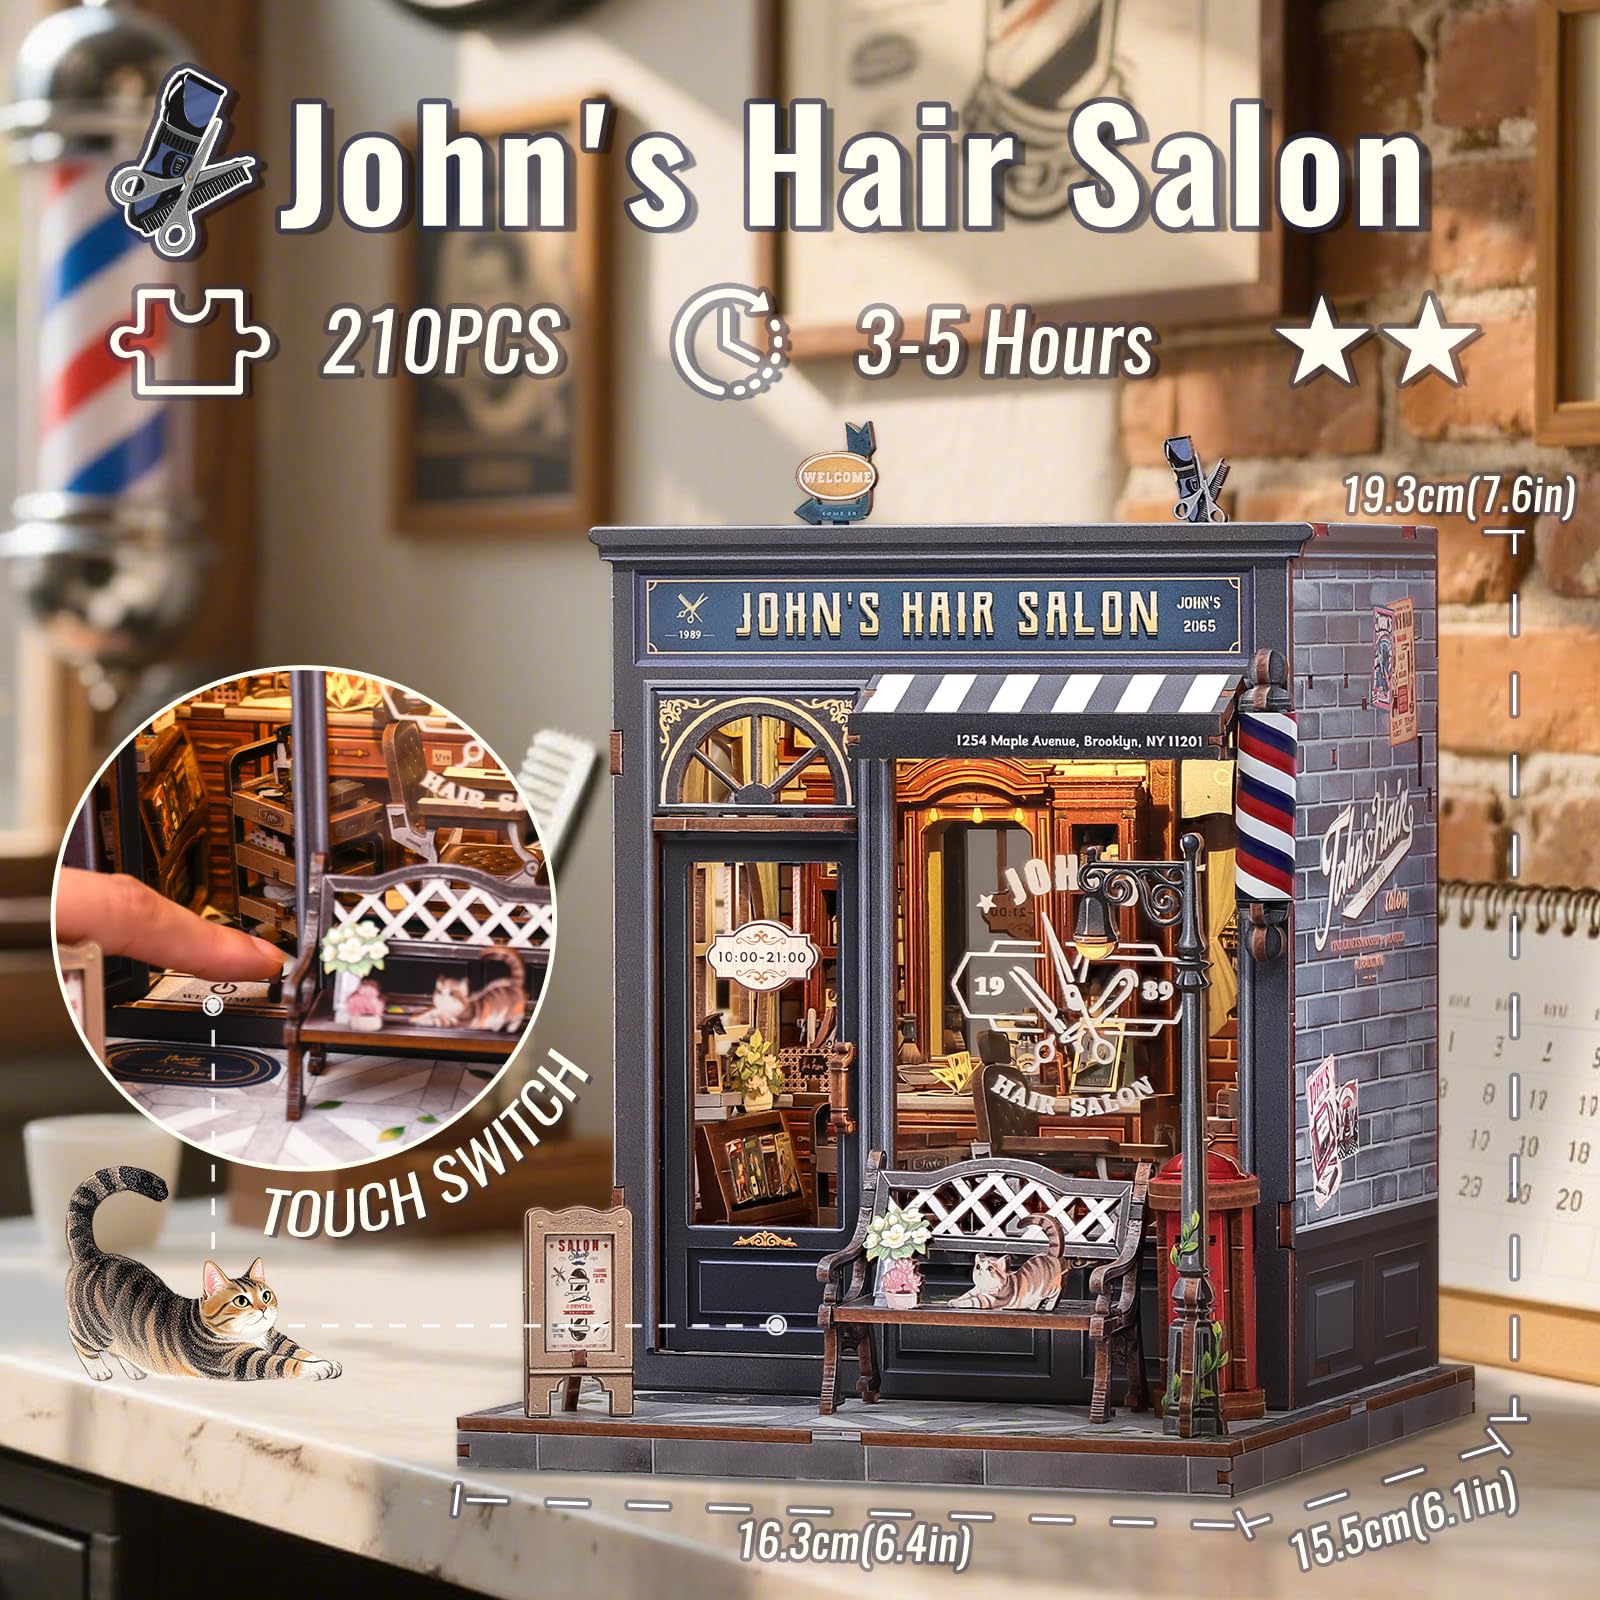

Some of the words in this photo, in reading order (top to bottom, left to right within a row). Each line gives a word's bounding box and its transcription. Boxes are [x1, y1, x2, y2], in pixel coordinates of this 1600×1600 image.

[803, 471, 872, 484] WELCOME
[1176, 595, 1222, 610] JOHN'S
[735, 591, 881, 637] JOHN'S
[902, 591, 995, 637] HAIR
[1017, 591, 1159, 636] SALON
[1182, 618, 1217, 633] 2065
[678, 629, 702, 640] 1989
[956, 734, 988, 747] 1254
[990, 734, 1030, 749] Maple
[1031, 734, 1080, 749] Avenue,
[1083, 734, 1142, 750] Brooklyn,
[1146, 734, 1166, 748] NY
[1168, 734, 1203, 748] 11201
[420, 769, 486, 809] HAIR
[717, 951, 807, 964] 10:00-21:00
[974, 976, 1005, 996] 19
[1141, 981, 1174, 1001] 89
[989, 1074, 1056, 1116] HAIR
[1070, 1075, 1155, 1118] SALON
[558, 1239, 599, 1252] SALON
